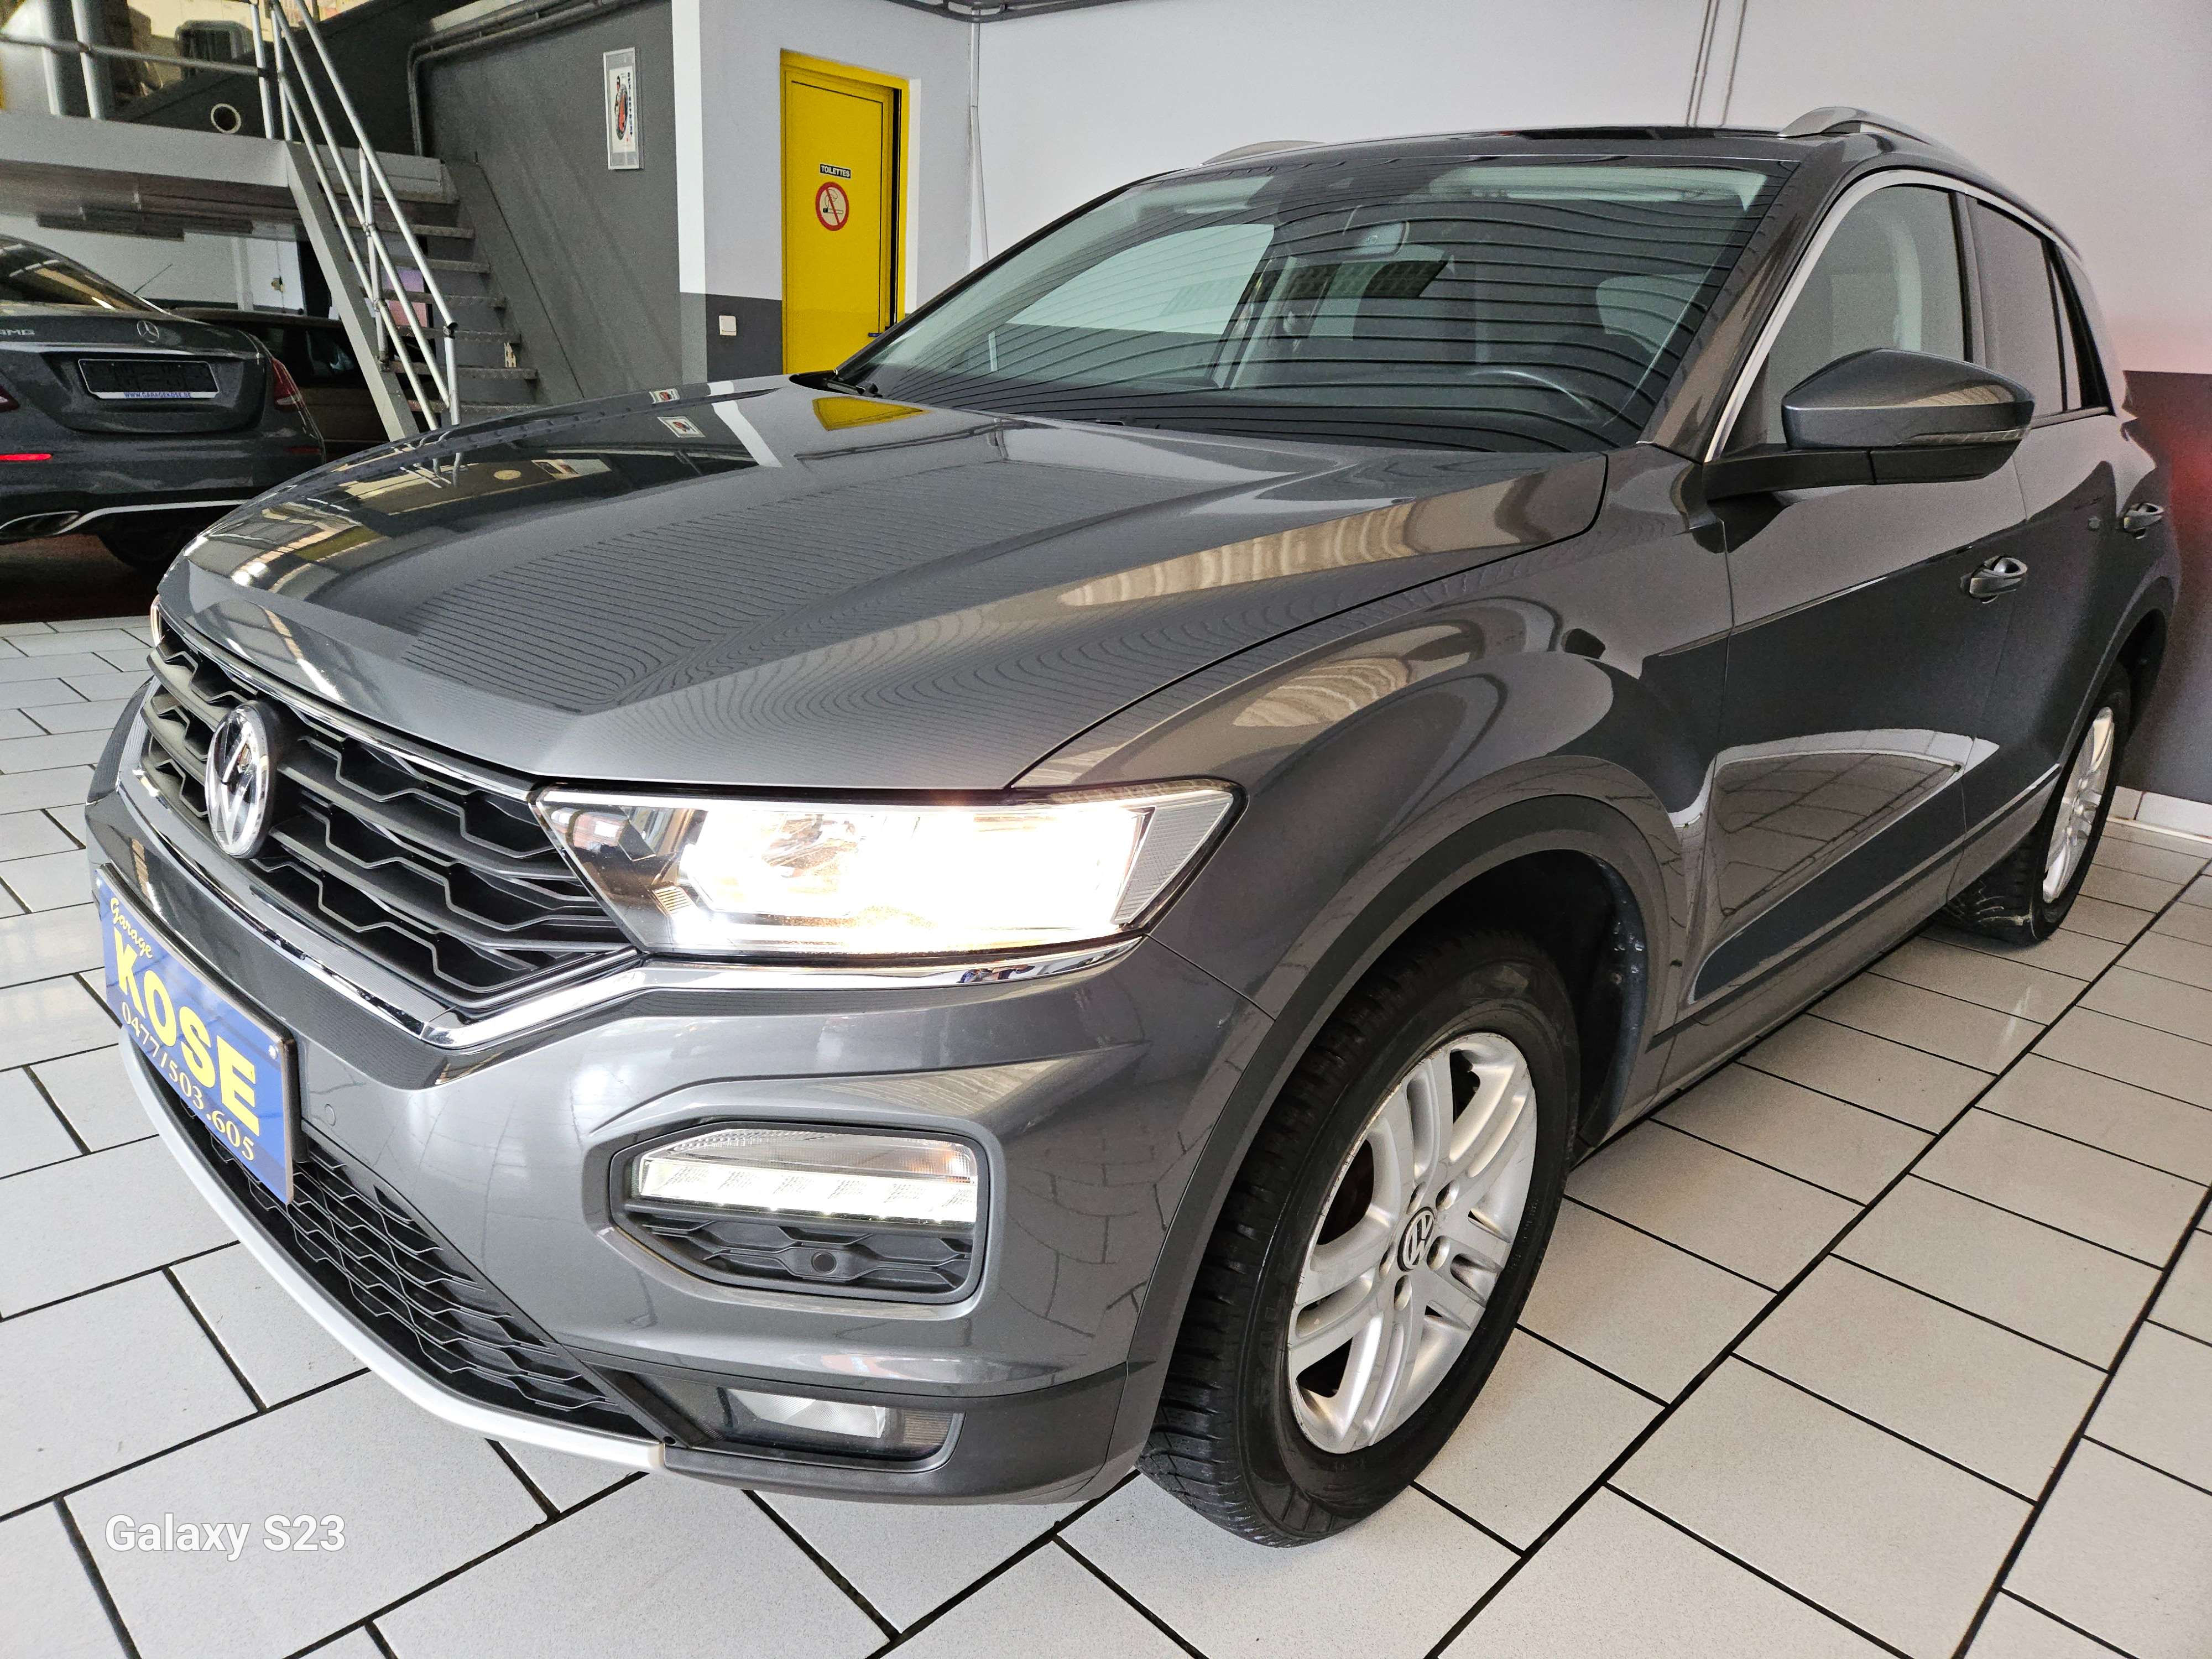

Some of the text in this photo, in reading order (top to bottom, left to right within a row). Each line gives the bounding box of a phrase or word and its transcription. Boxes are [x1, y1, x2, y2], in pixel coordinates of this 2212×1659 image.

[821, 165, 850, 177] TOILETTES
[111, 897, 153, 958] Garage
[114, 926, 260, 1137] KOSE
[122, 1001, 254, 1161] 0477/503.605
